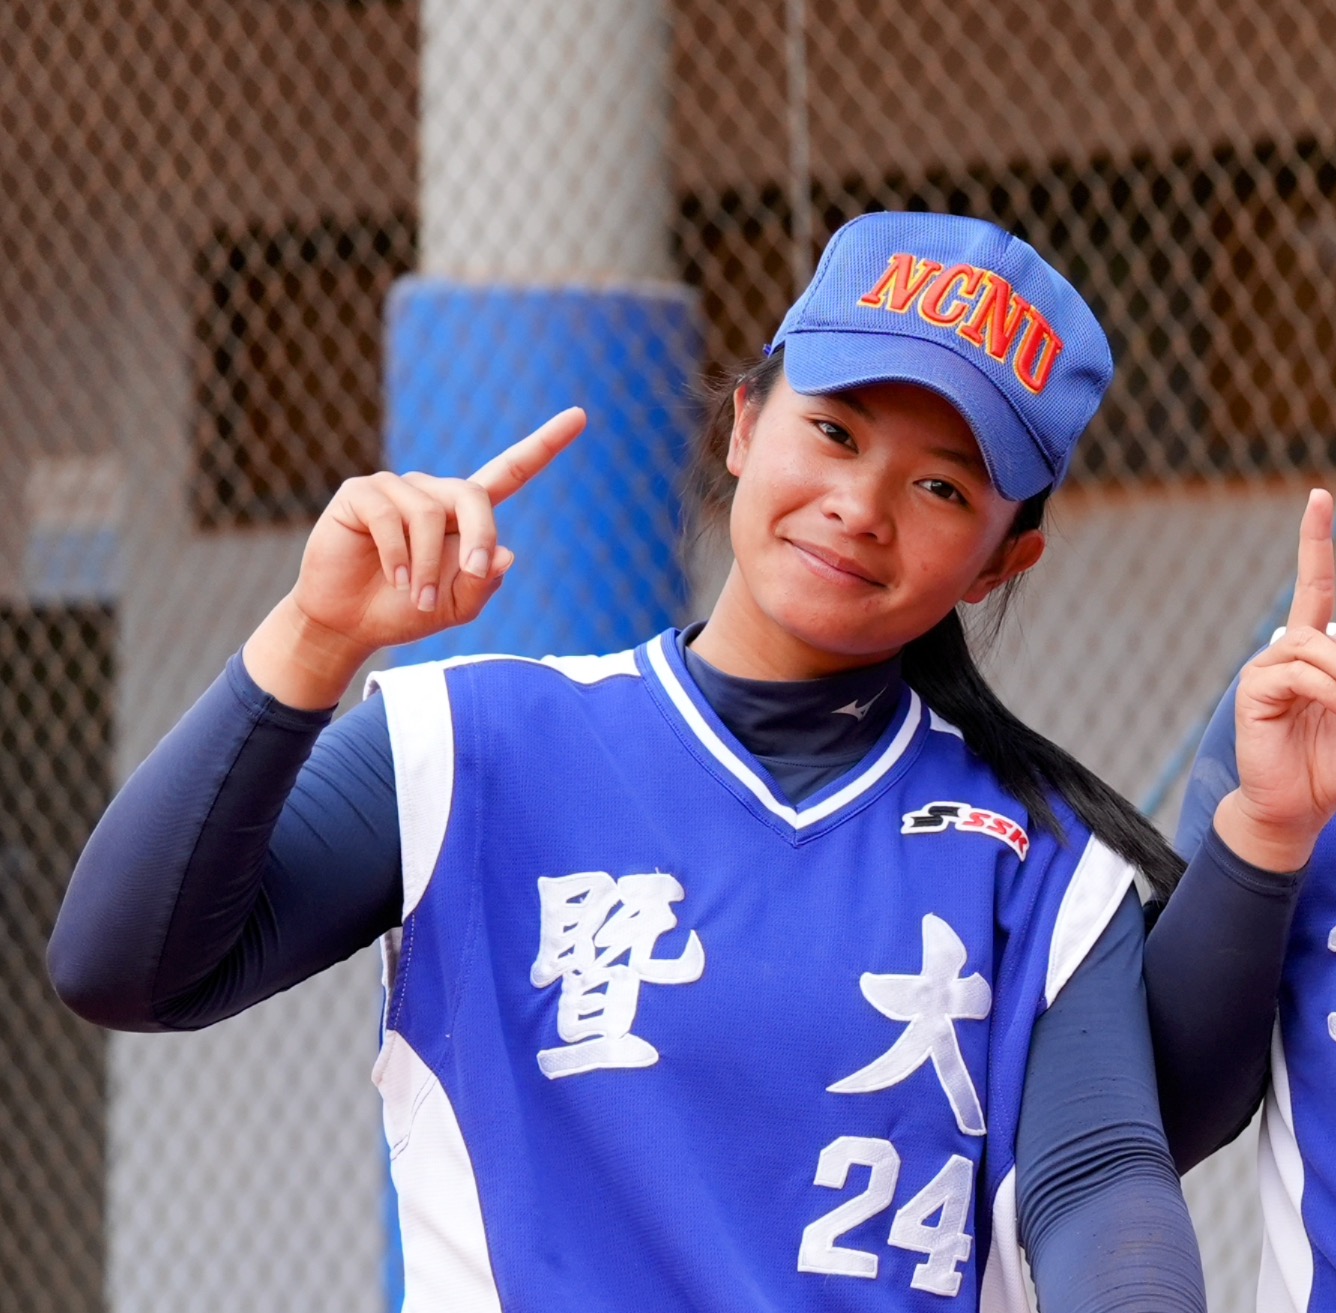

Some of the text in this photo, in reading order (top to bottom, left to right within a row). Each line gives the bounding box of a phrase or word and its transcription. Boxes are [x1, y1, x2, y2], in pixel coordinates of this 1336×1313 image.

[857, 252, 1063, 395] NCNU
[962, 811, 1028, 852] SSK
[798, 1135, 974, 1297] 24
